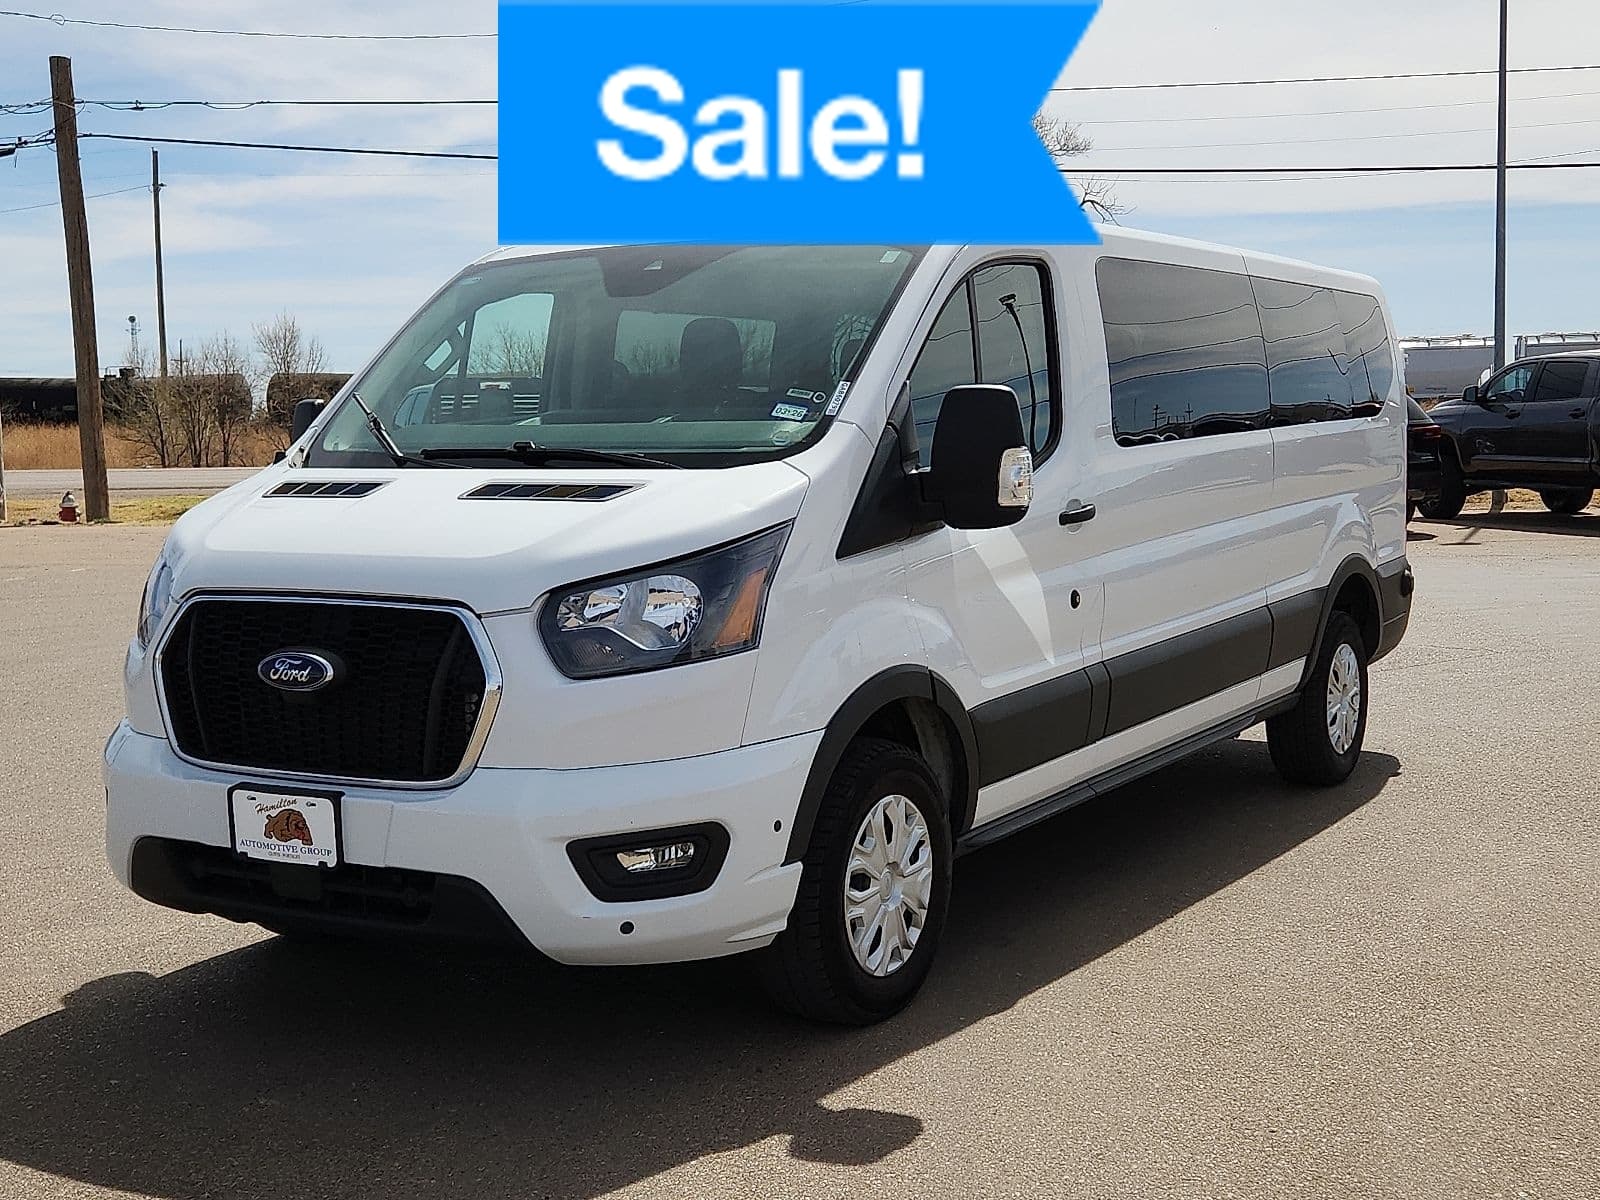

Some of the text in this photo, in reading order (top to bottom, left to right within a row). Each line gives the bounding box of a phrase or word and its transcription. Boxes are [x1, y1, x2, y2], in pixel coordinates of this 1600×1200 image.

[270, 658, 312, 682] Ford
[255, 798, 298, 815] Hamilton
[239, 839, 298, 854] AUTOMOTIVE
[300, 845, 332, 857] GROUP
